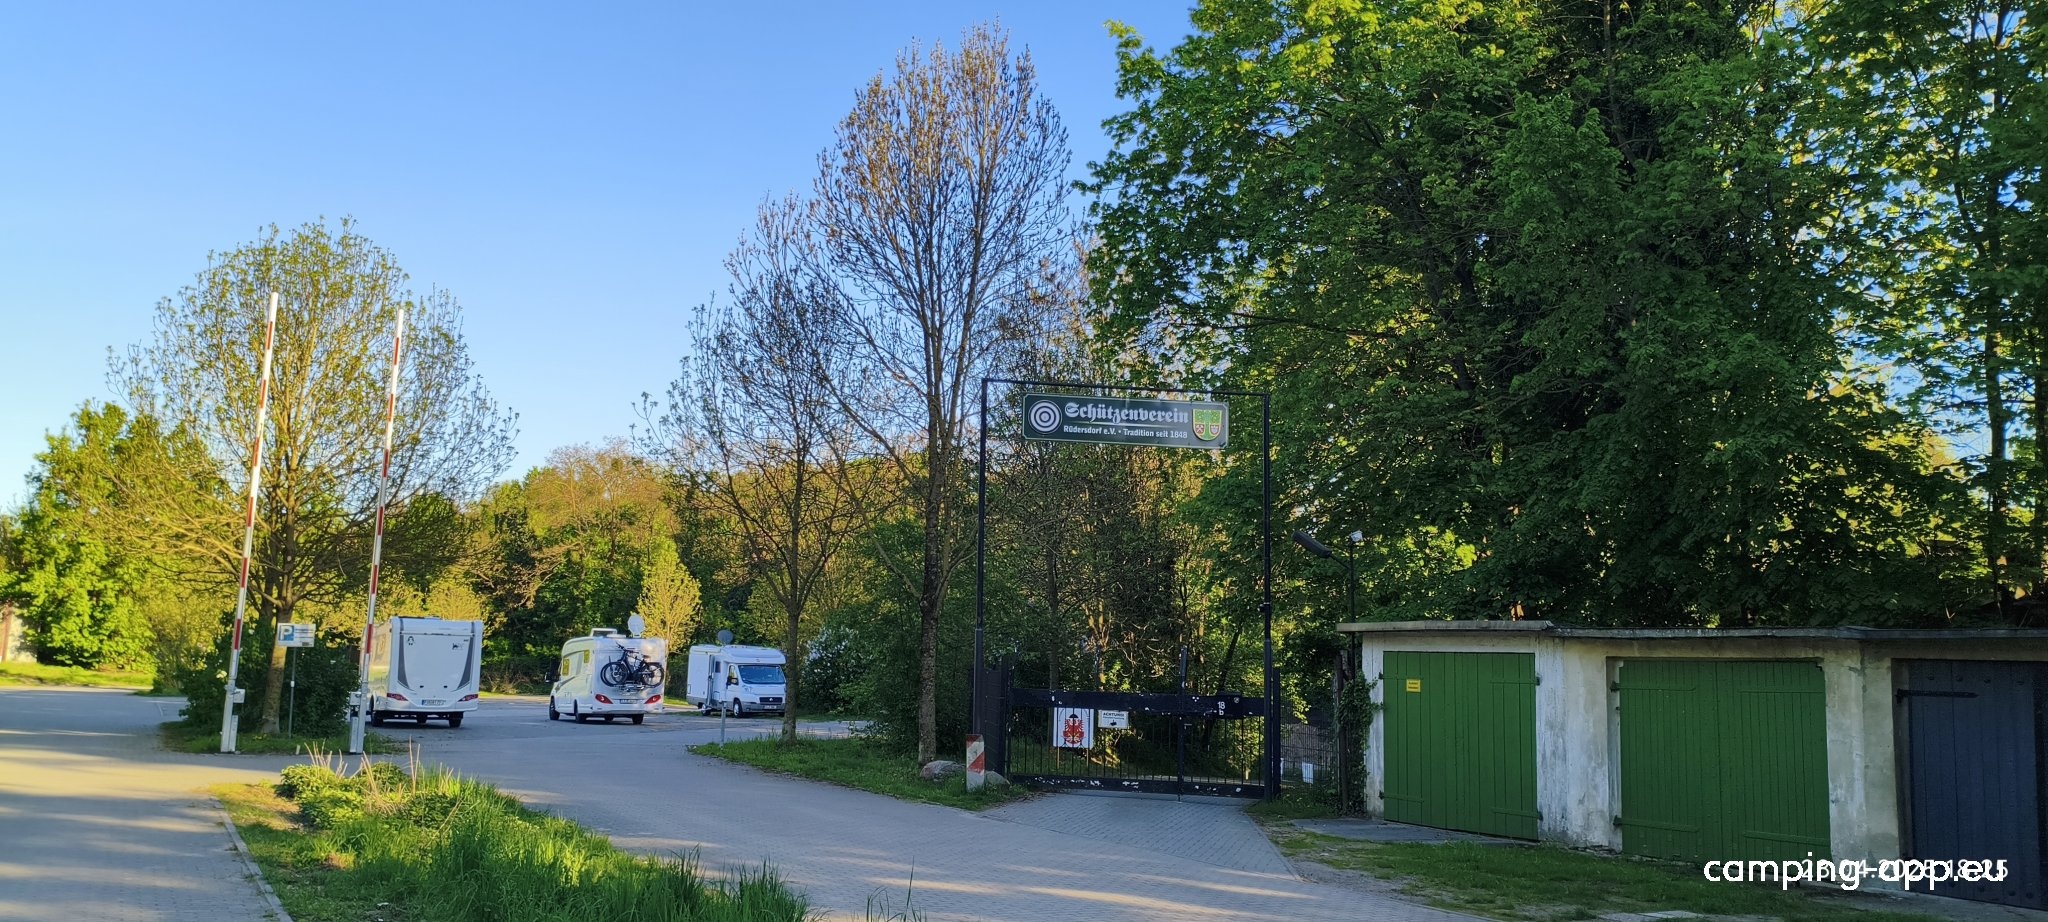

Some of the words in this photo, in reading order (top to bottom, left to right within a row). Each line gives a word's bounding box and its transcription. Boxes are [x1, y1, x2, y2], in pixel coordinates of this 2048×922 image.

[1064, 402, 1189, 424] Schützenverein
[1063, 425, 1102, 434] Rüdersdorf
[1103, 427, 1117, 435] e.V.
[1123, 428, 1154, 437] Tradition
[1155, 430, 1169, 438] seit
[1170, 430, 1188, 439] 1848
[1217, 701, 1226, 710] 18
